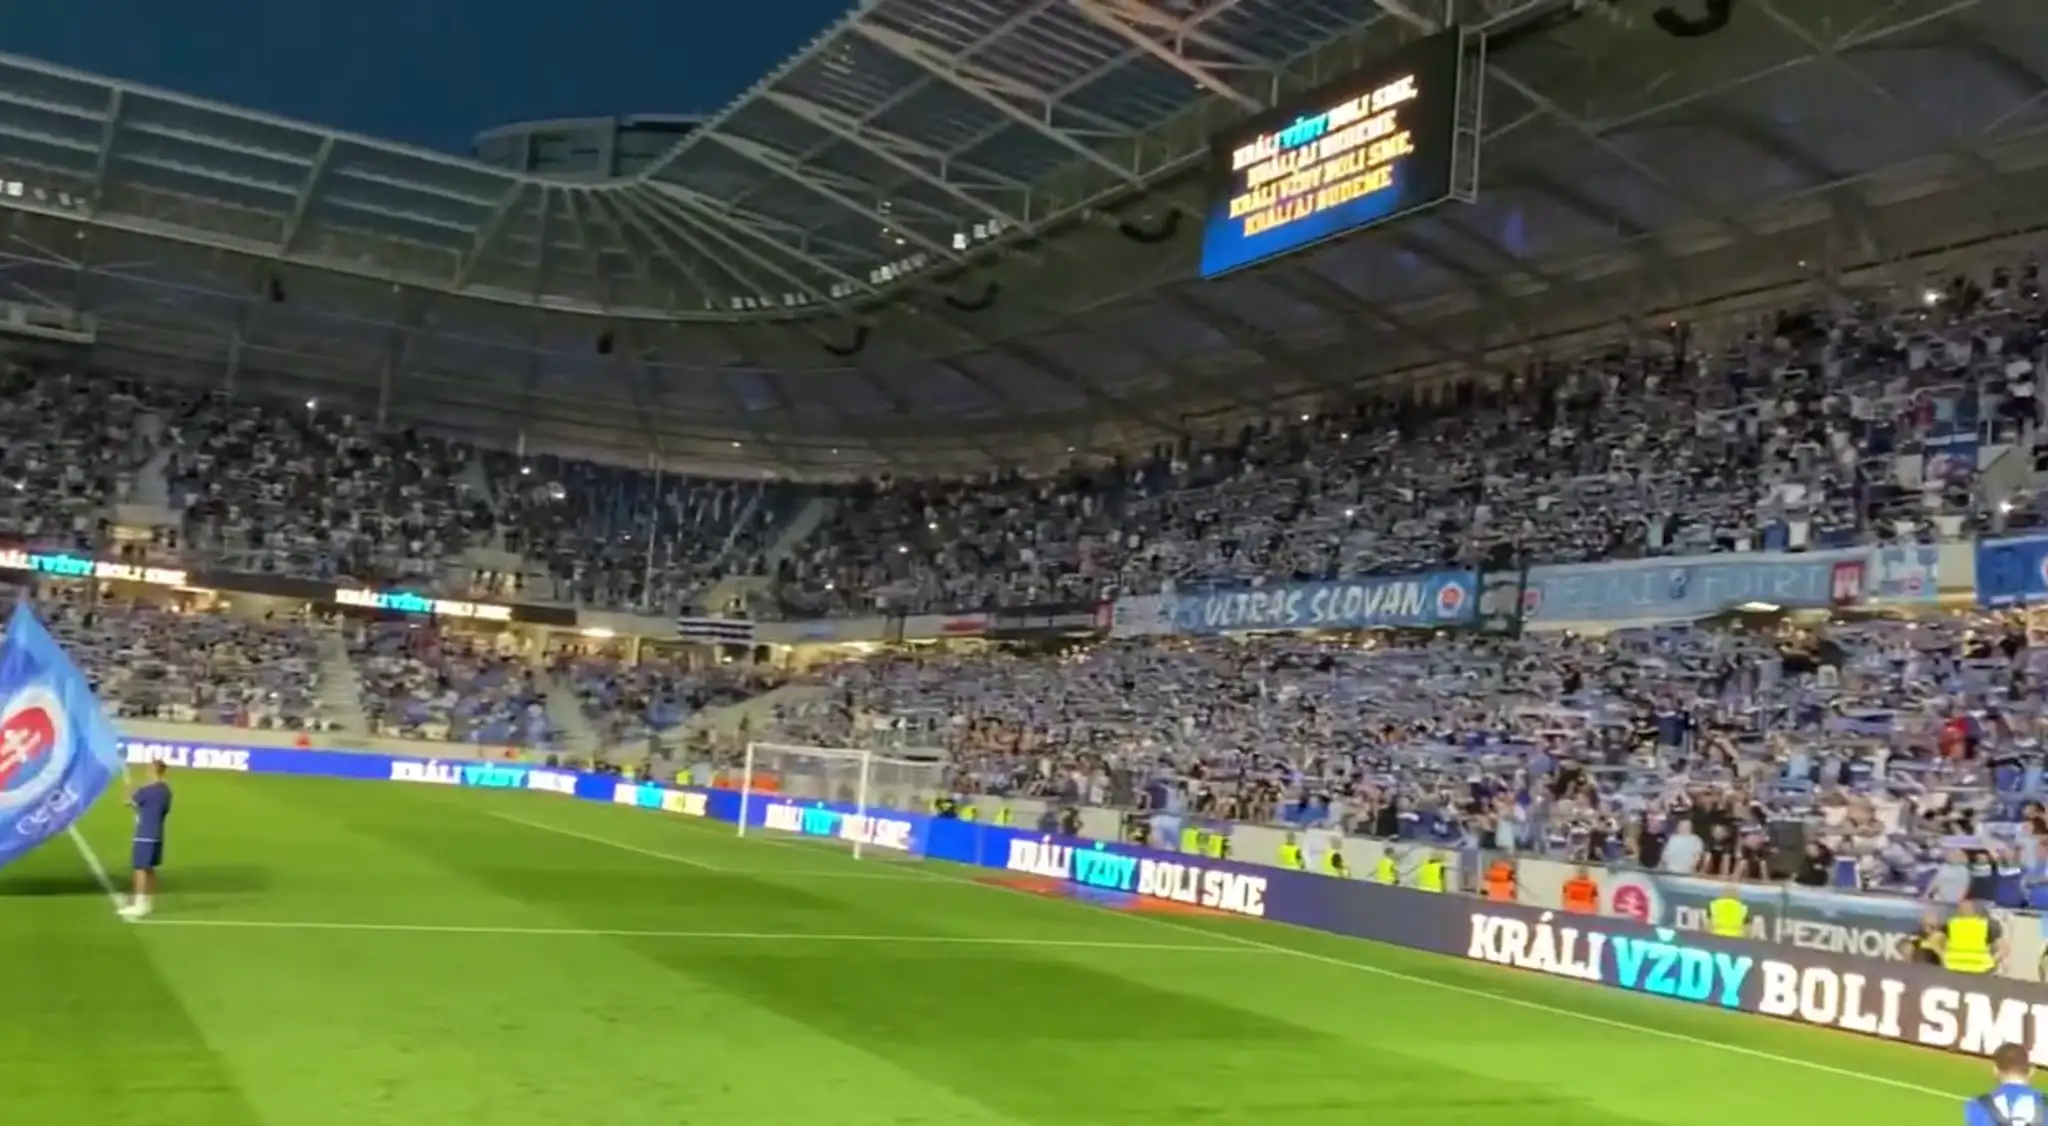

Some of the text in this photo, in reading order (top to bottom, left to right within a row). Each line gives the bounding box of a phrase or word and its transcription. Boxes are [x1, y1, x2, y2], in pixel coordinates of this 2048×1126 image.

[1203, 587, 1301, 626] ULTRAS
[1310, 582, 1428, 624] SLOVAN
[1007, 834, 1267, 916] KRÁLI VŽDY BOLI SME
[1775, 917, 1908, 961] PEZINOK
[1467, 911, 1606, 981] KRÁLI
[1612, 927, 1752, 1012] VŽDY
[1759, 959, 1905, 1037] BOLI
